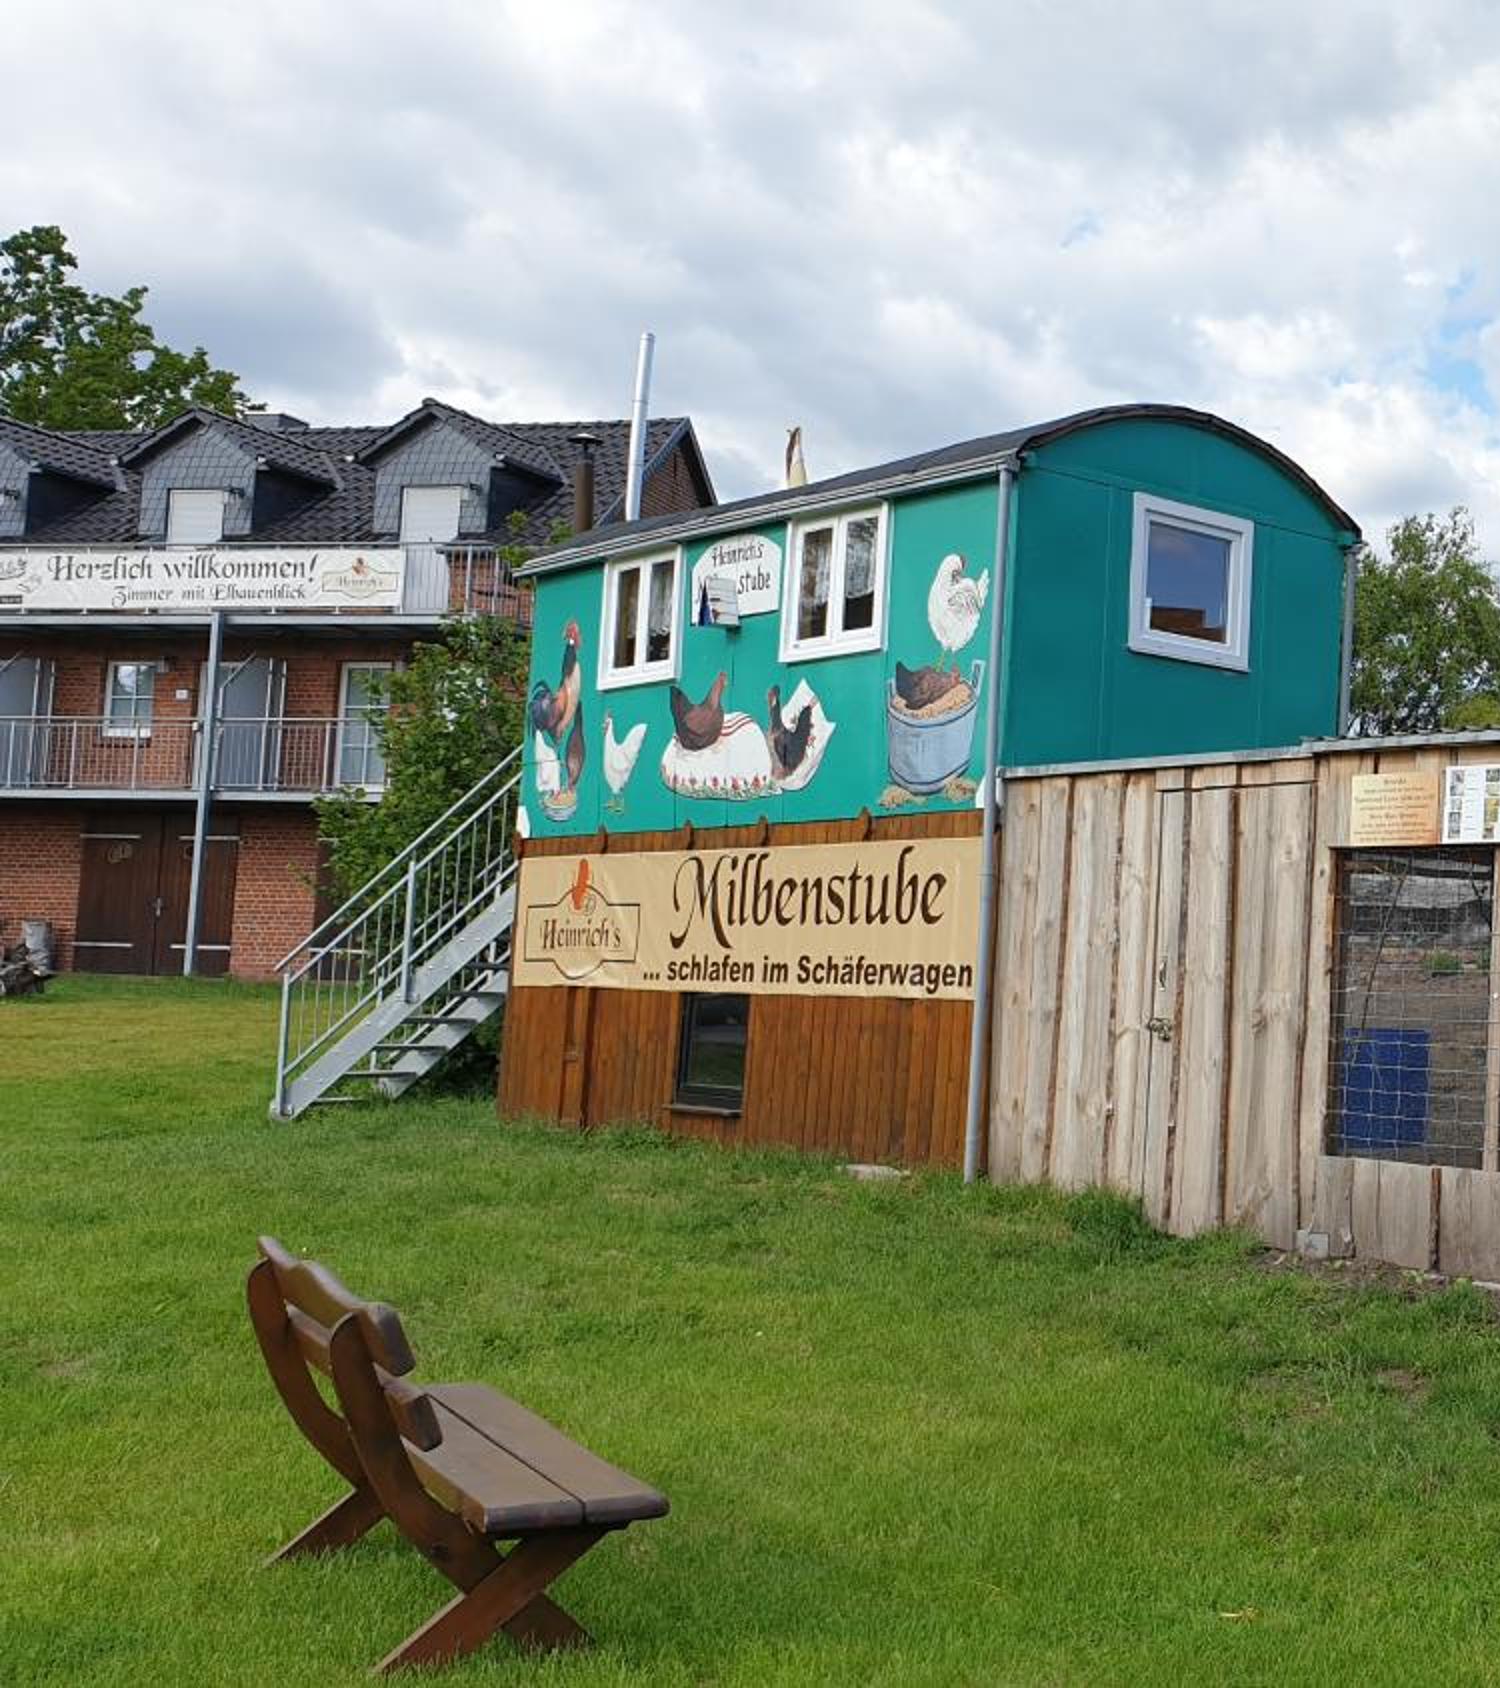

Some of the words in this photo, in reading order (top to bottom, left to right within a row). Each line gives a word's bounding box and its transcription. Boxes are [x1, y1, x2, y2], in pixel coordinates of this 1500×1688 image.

[47, 555, 153, 581] Herzlich
[164, 553, 321, 583] willkommen!
[111, 585, 174, 609] Zimmer
[181, 584, 206, 600] mit
[211, 583, 307, 601] Elbauenblick
[669, 845, 947, 949] Milbenstube
[667, 955, 756, 983] schlafen
[762, 956, 789, 984] im
[797, 954, 974, 995] Schäferwagen
